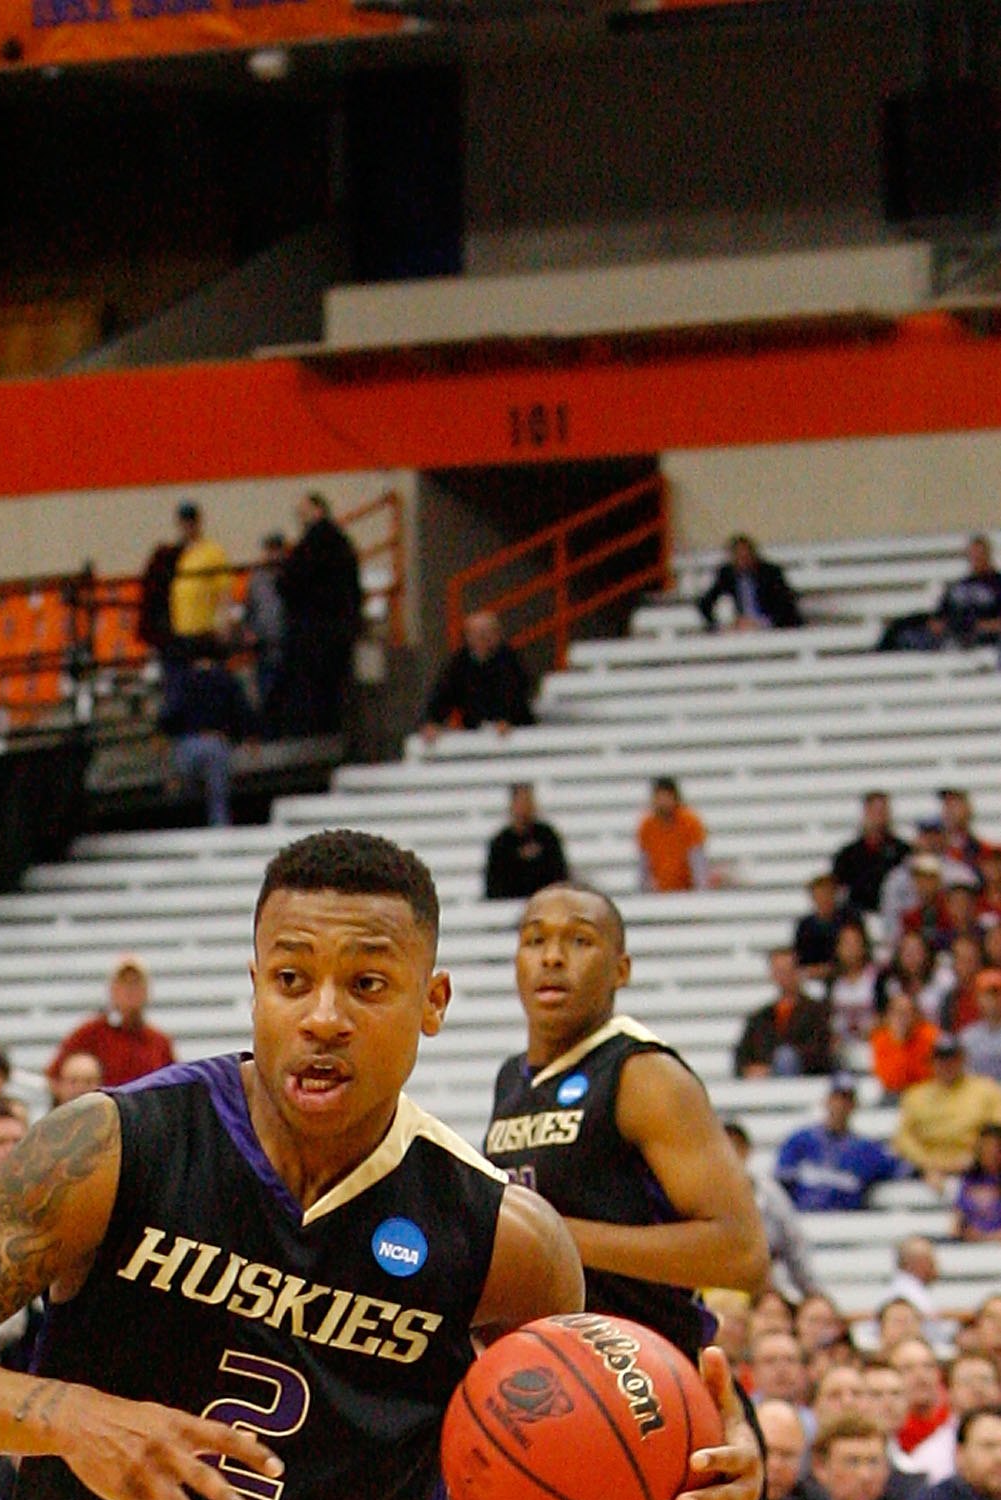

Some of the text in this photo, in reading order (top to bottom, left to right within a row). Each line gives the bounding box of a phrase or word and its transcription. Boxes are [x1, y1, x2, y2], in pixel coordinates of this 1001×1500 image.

[507, 402, 568, 447] 101
[378, 1241, 419, 1265] NCAA
[117, 1225, 444, 1364] HUSKIES
